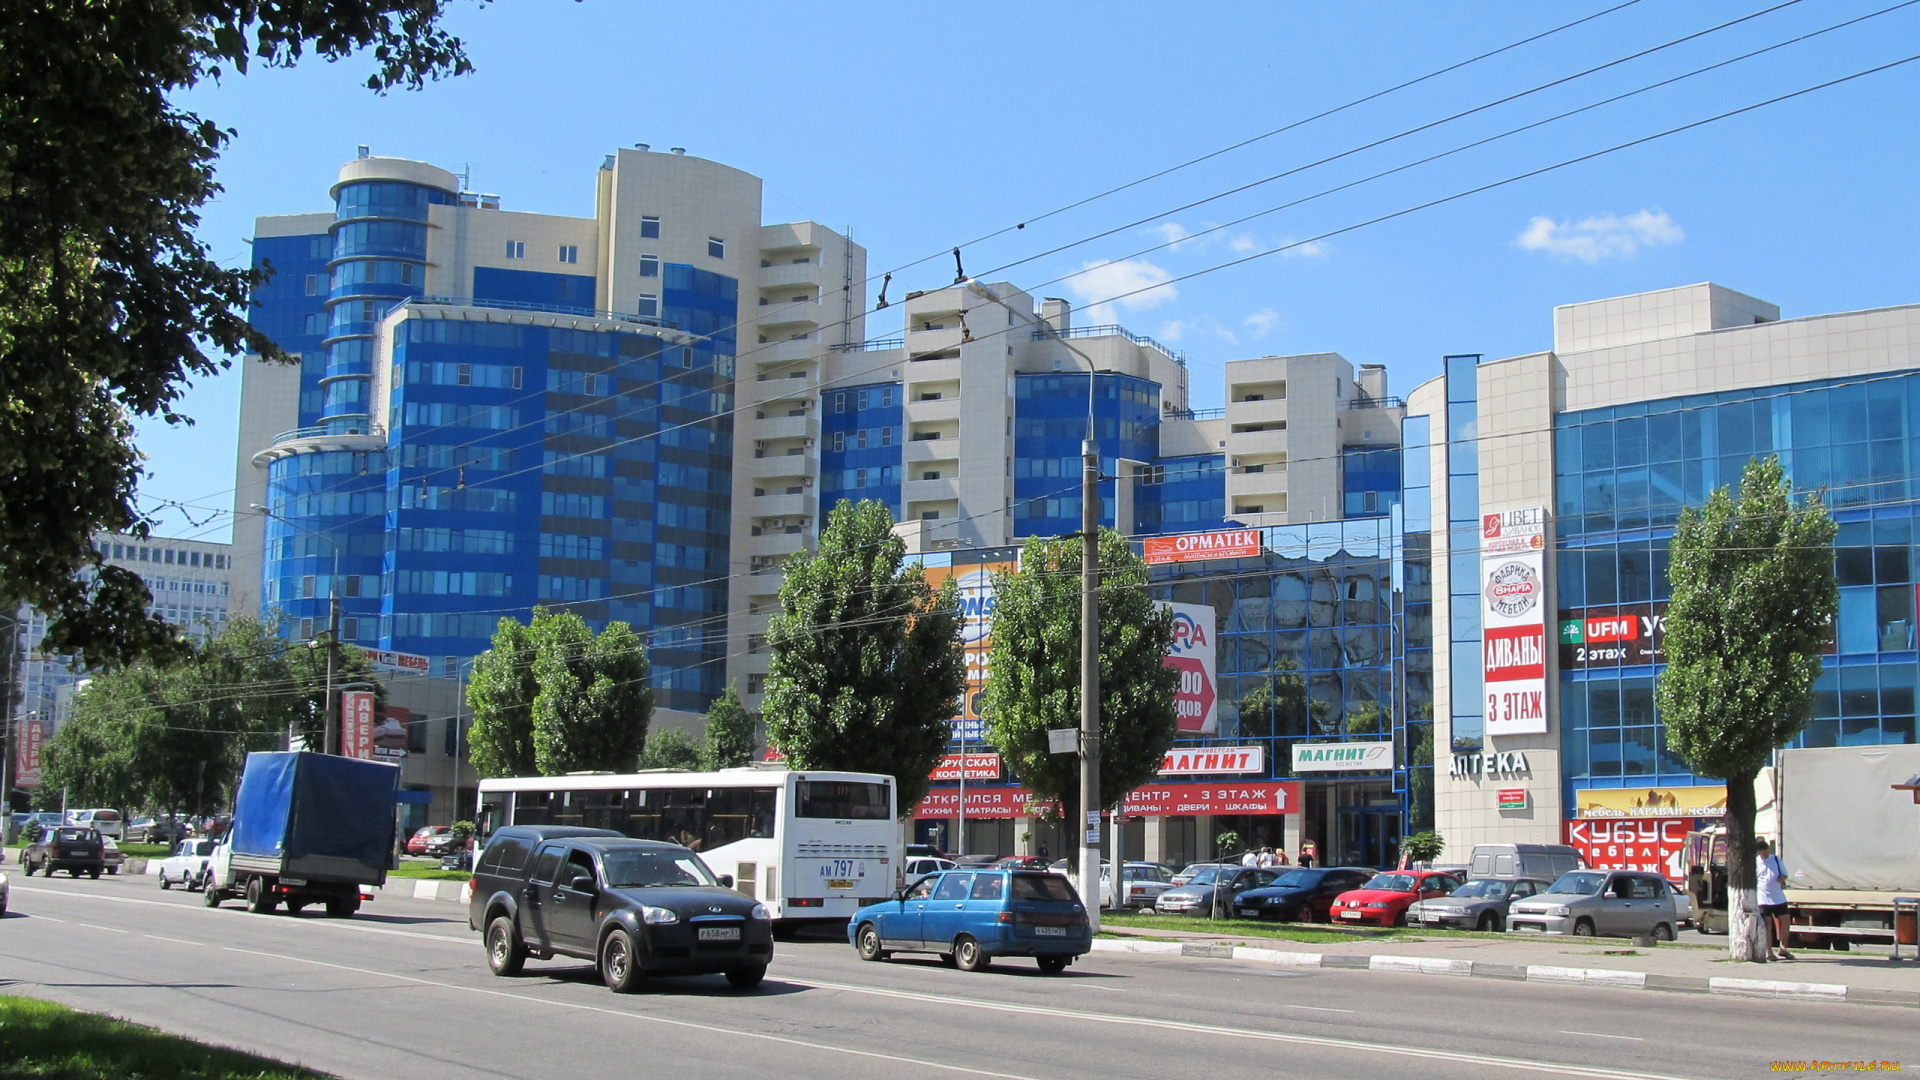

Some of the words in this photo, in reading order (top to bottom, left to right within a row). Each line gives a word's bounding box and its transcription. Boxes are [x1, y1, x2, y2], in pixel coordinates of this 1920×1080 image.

[1501, 508, 1540, 527] ЦВЕТ
[1175, 531, 1254, 551] ОРМАТЕК
[1494, 565, 1530, 584] ФАБРИКА
[1496, 597, 1530, 614] МЕБЕЛИ
[1587, 620, 1628, 637] UFM
[1486, 635, 1543, 672] ДИВАНЫ
[1576, 648, 1585, 661] 2
[1589, 648, 1626, 660] этаж
[1489, 693, 1497, 722] 3
[1503, 691, 1543, 721] ЭТАЖ
[358, 699, 370, 759] ДВЕРИ
[937, 758, 997, 767] ОРУССКАЯ
[1298, 748, 1367, 762] МАГНИТ
[1448, 752, 1527, 775] АПТЕКА
[936, 769, 997, 778] КОСМЕТИКА
[922, 794, 1002, 805] ОТКРЫЛСЯ
[1201, 790, 1210, 800] 3
[1217, 789, 1267, 799] ЭТАЖ
[965, 806, 1012, 814] МАТРАСЫ
[1176, 803, 1210, 812] ДВЕРИ
[1225, 802, 1267, 811] ШКАФЫ
[1583, 807, 1625, 817] мебель
[1629, 806, 1683, 816] КАРАВАН
[1569, 820, 1683, 844] КУБУС
[820, 866, 831, 877] АМ
[833, 859, 853, 877] 797
